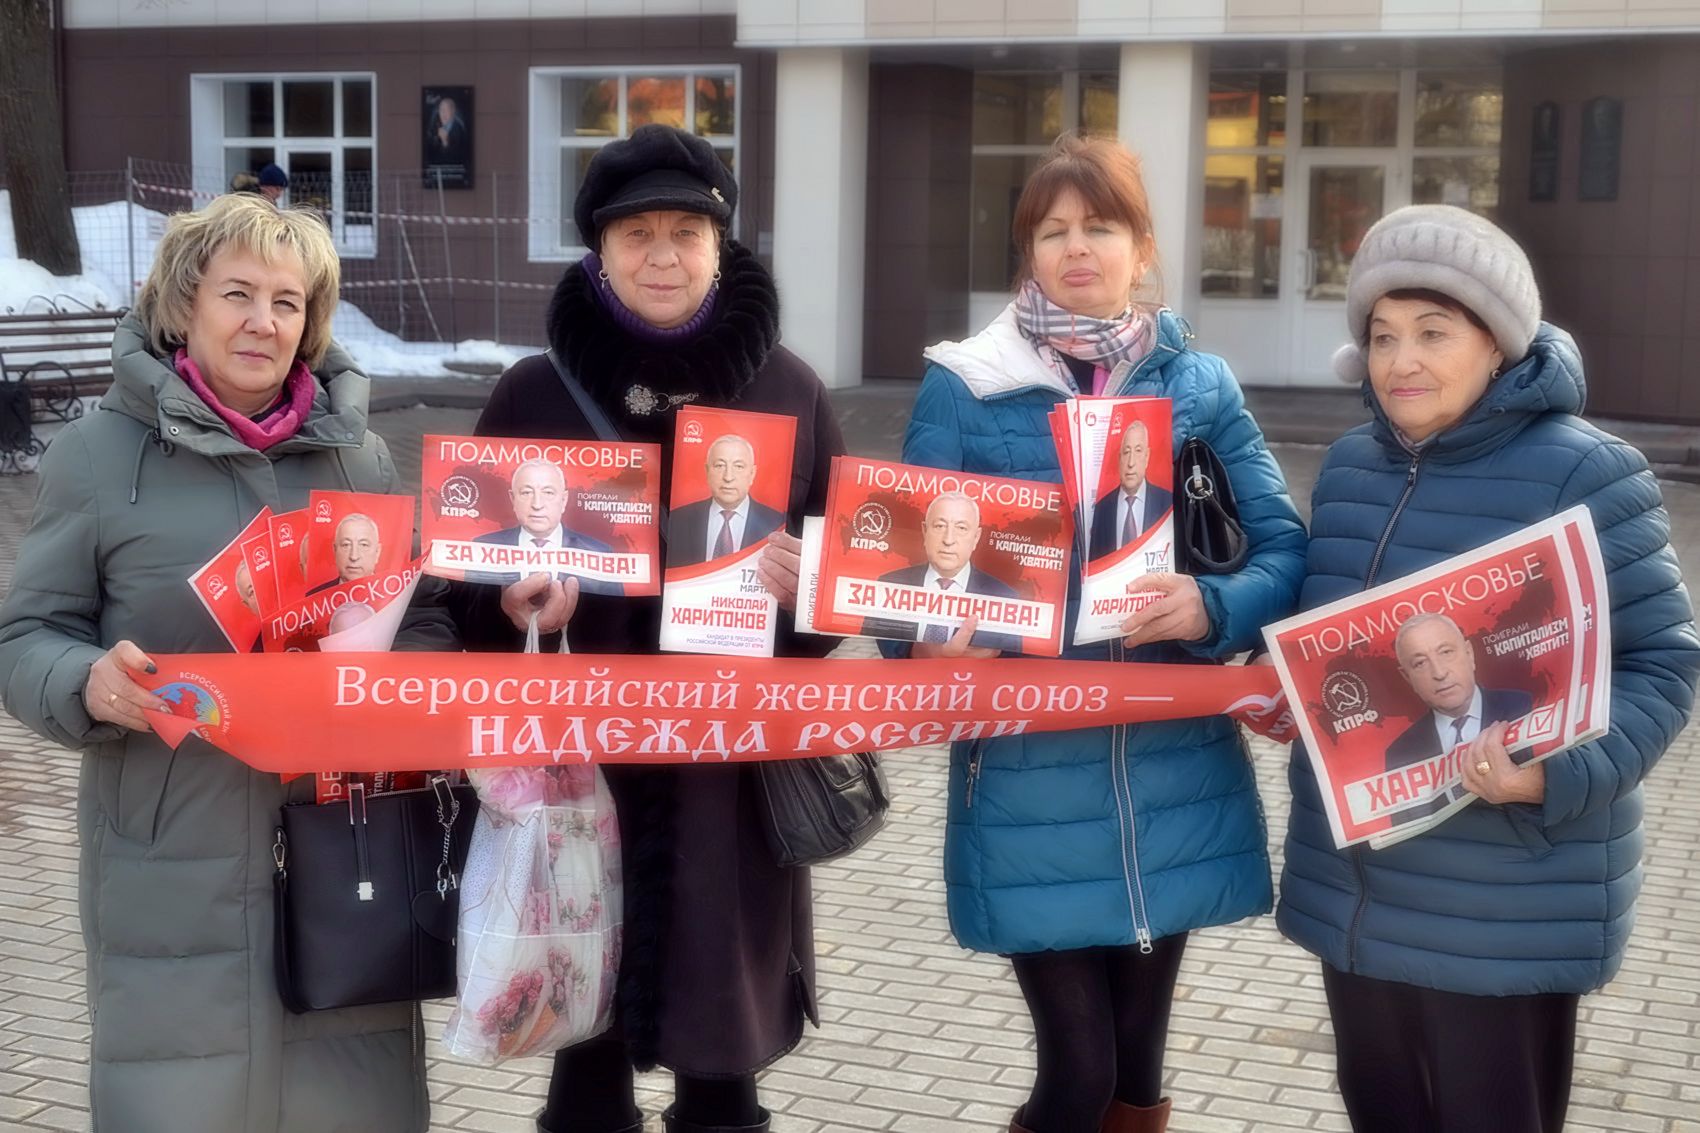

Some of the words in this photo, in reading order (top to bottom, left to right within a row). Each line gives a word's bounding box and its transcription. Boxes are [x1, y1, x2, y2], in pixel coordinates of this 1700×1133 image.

[440, 441, 643, 469] ПОДМОСКОВЬЕ
[857, 464, 1061, 512] ПОДМОСКОВЬЕ
[441, 506, 480, 518] КПРФ
[584, 501, 652, 513] КАПИТАЛИЗМ
[609, 513, 652, 524] ХВАТИТ!
[850, 537, 889, 551] КПРФ
[990, 531, 1031, 542] ПОИГРАЛИ
[445, 544, 473, 563] ЗА
[481, 547, 636, 575] ХАРИТОНОВА!
[996, 540, 1064, 558] КАПИТАЛИЗМ
[1145, 552, 1156, 566] 17
[1020, 556, 1063, 570] ХВАТИТ!
[741, 568, 757, 584] 17
[711, 596, 768, 611] НИКОЛАЙ
[848, 583, 875, 606] ЗА
[882, 587, 1040, 627] ХАРИТОНОВА!
[1298, 553, 1543, 662] ПОДМОСКОВЬЕ
[671, 607, 767, 630] ХАРИТОНОВ
[1482, 622, 1530, 645] ПОИГРАЛИ
[1486, 646, 1493, 655] В
[1494, 617, 1568, 656] КАПИТАЛИЗМ
[1525, 632, 1569, 660] ХВАТИТ!
[335, 666, 738, 714] Всероссийский
[753, 672, 975, 712] женский
[992, 684, 1108, 712] союз
[1332, 710, 1378, 734] КПРФ
[468, 715, 770, 761] НАДЕЖДА
[793, 720, 1033, 751] РОССИИ
